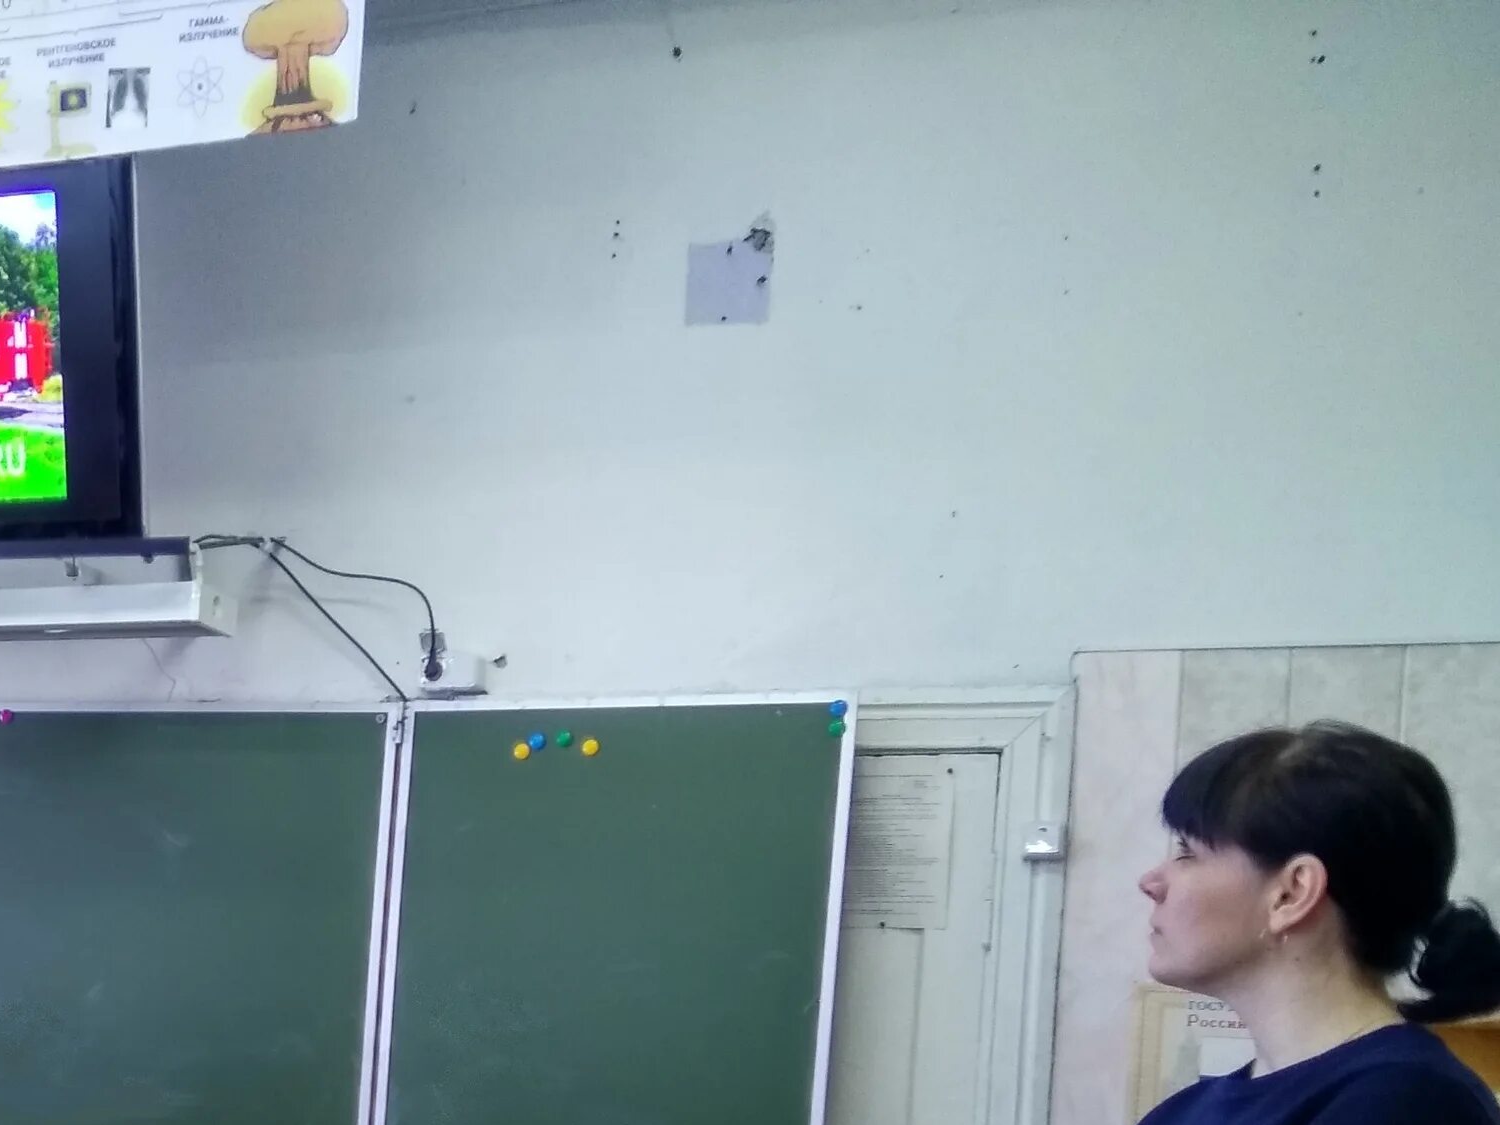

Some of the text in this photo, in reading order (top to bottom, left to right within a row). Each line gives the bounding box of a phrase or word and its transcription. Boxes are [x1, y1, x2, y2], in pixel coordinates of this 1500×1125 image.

[179, 27, 239, 43] ИЗЛУЧЕНИЕ
[36, 37, 117, 57] РЕНТГЕНОВСКОЕ
[48, 53, 105, 68] ИЗЛУЧЕНИЕ
